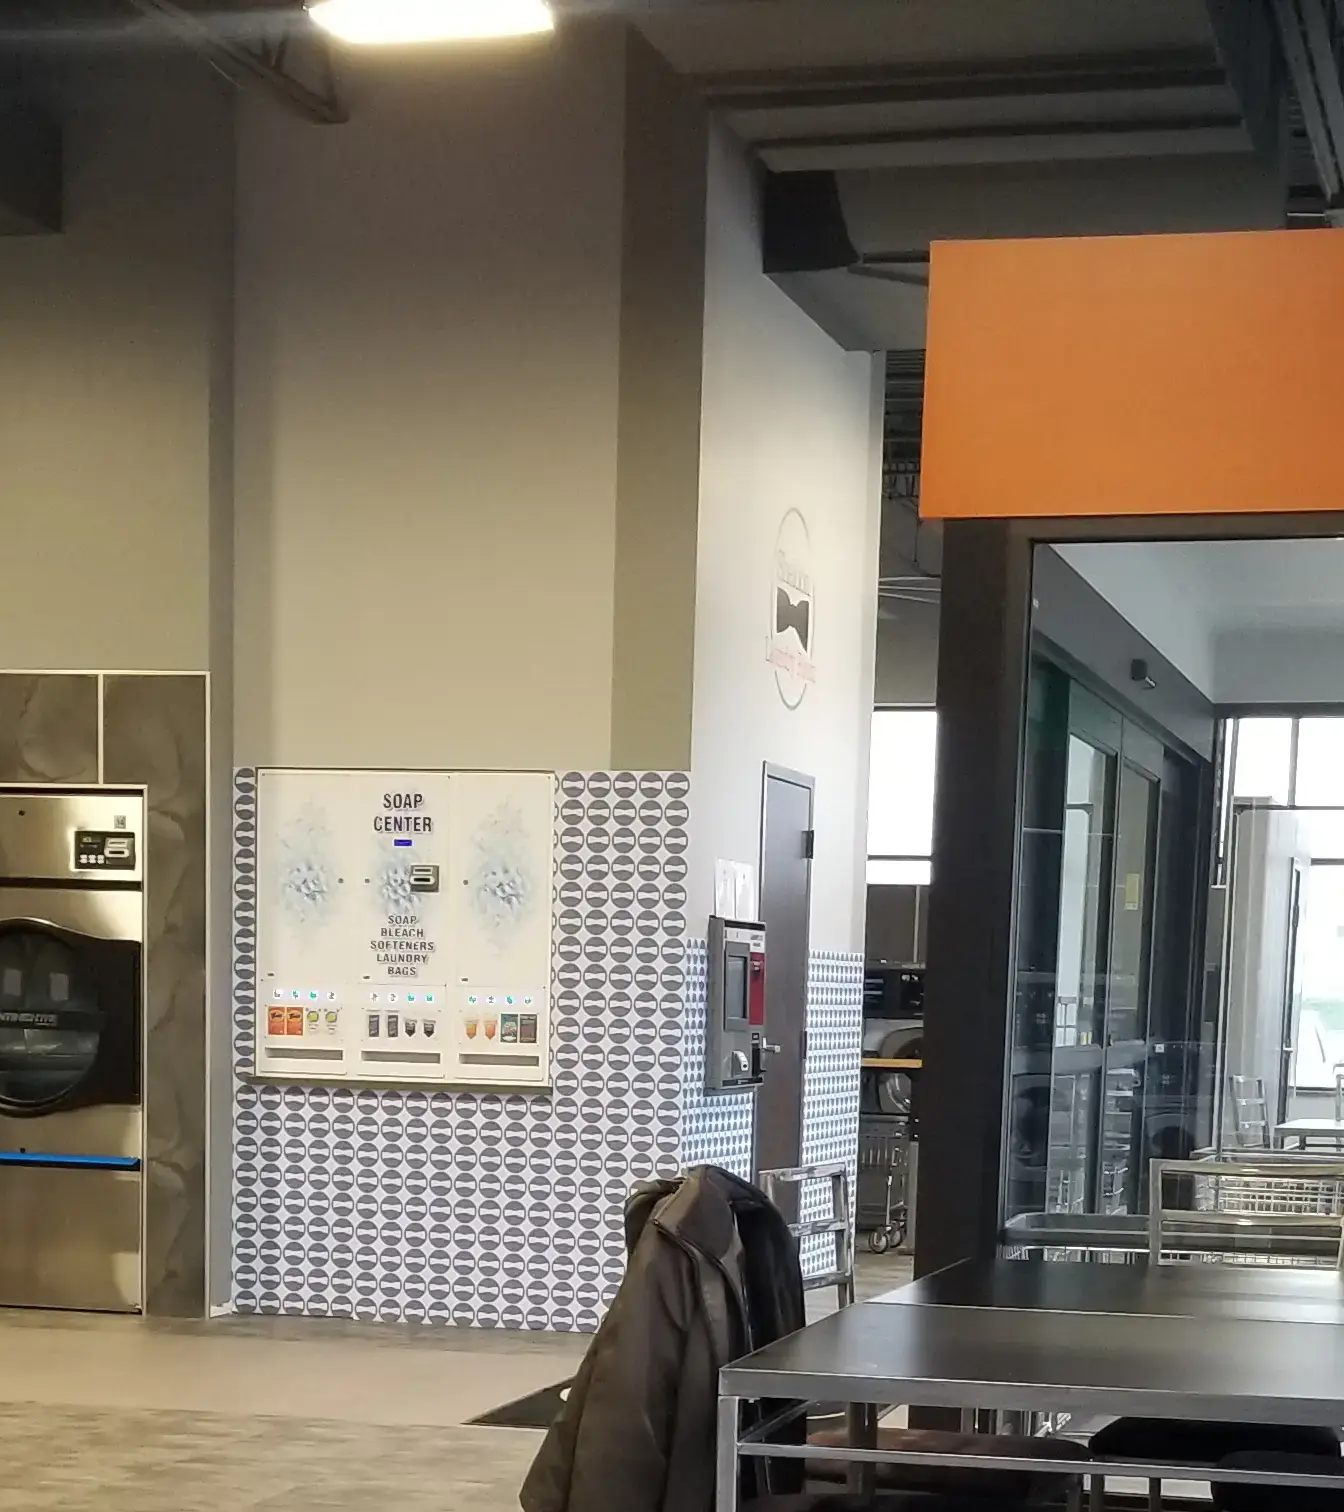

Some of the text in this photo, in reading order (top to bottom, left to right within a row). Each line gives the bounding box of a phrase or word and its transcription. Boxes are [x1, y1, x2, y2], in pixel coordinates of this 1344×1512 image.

[383, 793, 423, 809] SOAP
[373, 815, 432, 832] CENTER
[387, 915, 417, 925] SOAP
[380, 927, 424, 937] BLEACH
[370, 940, 434, 951] SOFTENERS
[376, 953, 427, 963] LAUNDRY
[387, 966, 417, 976] BAGS
